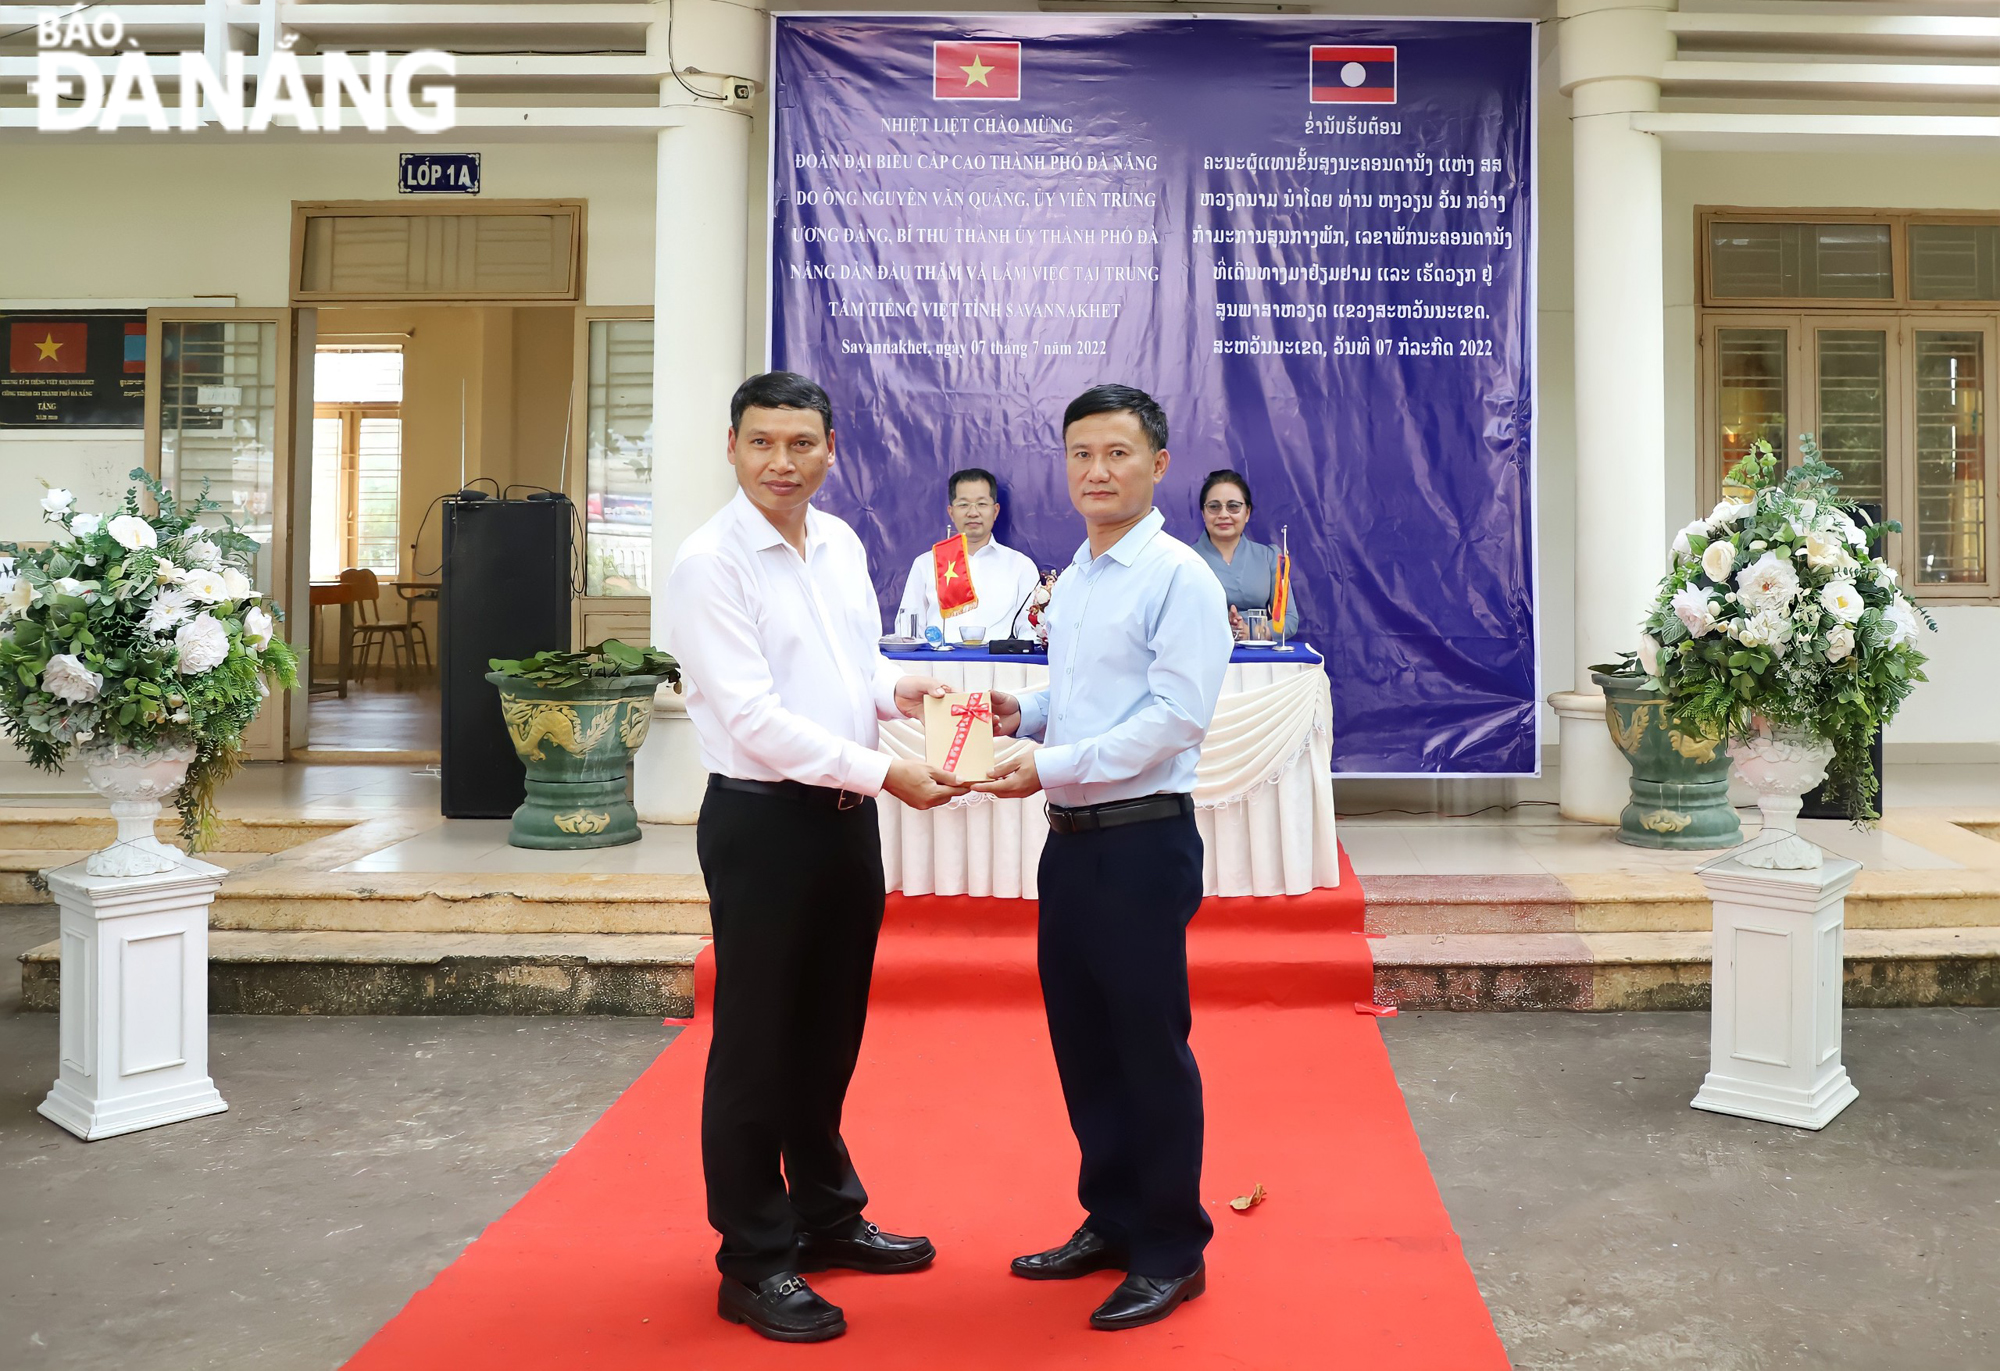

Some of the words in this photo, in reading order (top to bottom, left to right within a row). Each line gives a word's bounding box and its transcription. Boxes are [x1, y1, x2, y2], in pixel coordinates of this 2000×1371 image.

[880, 115, 930, 136] NHIỆT
[933, 115, 970, 136] LIỆT
[973, 114, 1020, 134] CHÀO
[1023, 114, 1073, 134] MỪNG
[795, 149, 840, 169] ĐOÀN
[844, 152, 871, 172] ĐẠI
[952, 154, 986, 170] CAO
[990, 151, 1045, 171] THÀNH
[1087, 151, 1109, 171] ĐÀ
[407, 157, 442, 186] LỚP
[446, 164, 472, 187] 1A
[796, 190, 818, 206] DO
[822, 186, 857, 206] ÔNG
[932, 188, 964, 206] VĂN
[1059, 187, 1097, 207] VIÊN
[1101, 192, 1157, 207] TRUNG
[792, 225, 839, 243] ƯƠNG
[897, 223, 912, 243] BÍ
[916, 226, 952, 243] THƯ
[954, 224, 1010, 244] THÀNH
[1040, 224, 1095, 244] THÀNH
[1137, 224, 1159, 245] ĐÀ
[914, 261, 961, 280] THĂM
[966, 261, 987, 280] VÀ
[992, 262, 1027, 281] LÀM
[1031, 264, 1070, 285] VIỆC
[1073, 266, 1099, 285] TẠI
[1104, 266, 1160, 282] TRUNG
[828, 297, 864, 317] TÂM
[1005, 302, 1122, 318] SAVANNAKHET
[841, 338, 932, 356] Savannakhet,
[936, 339, 967, 358] ngày
[970, 340, 986, 355] 07
[990, 339, 1028, 358] tháng
[1032, 340, 1039, 355] 7
[1043, 340, 1072, 355] năm
[1076, 340, 1107, 355] 2022
[1376, 338, 1393, 356] 07
[1459, 339, 1493, 356] 2022
